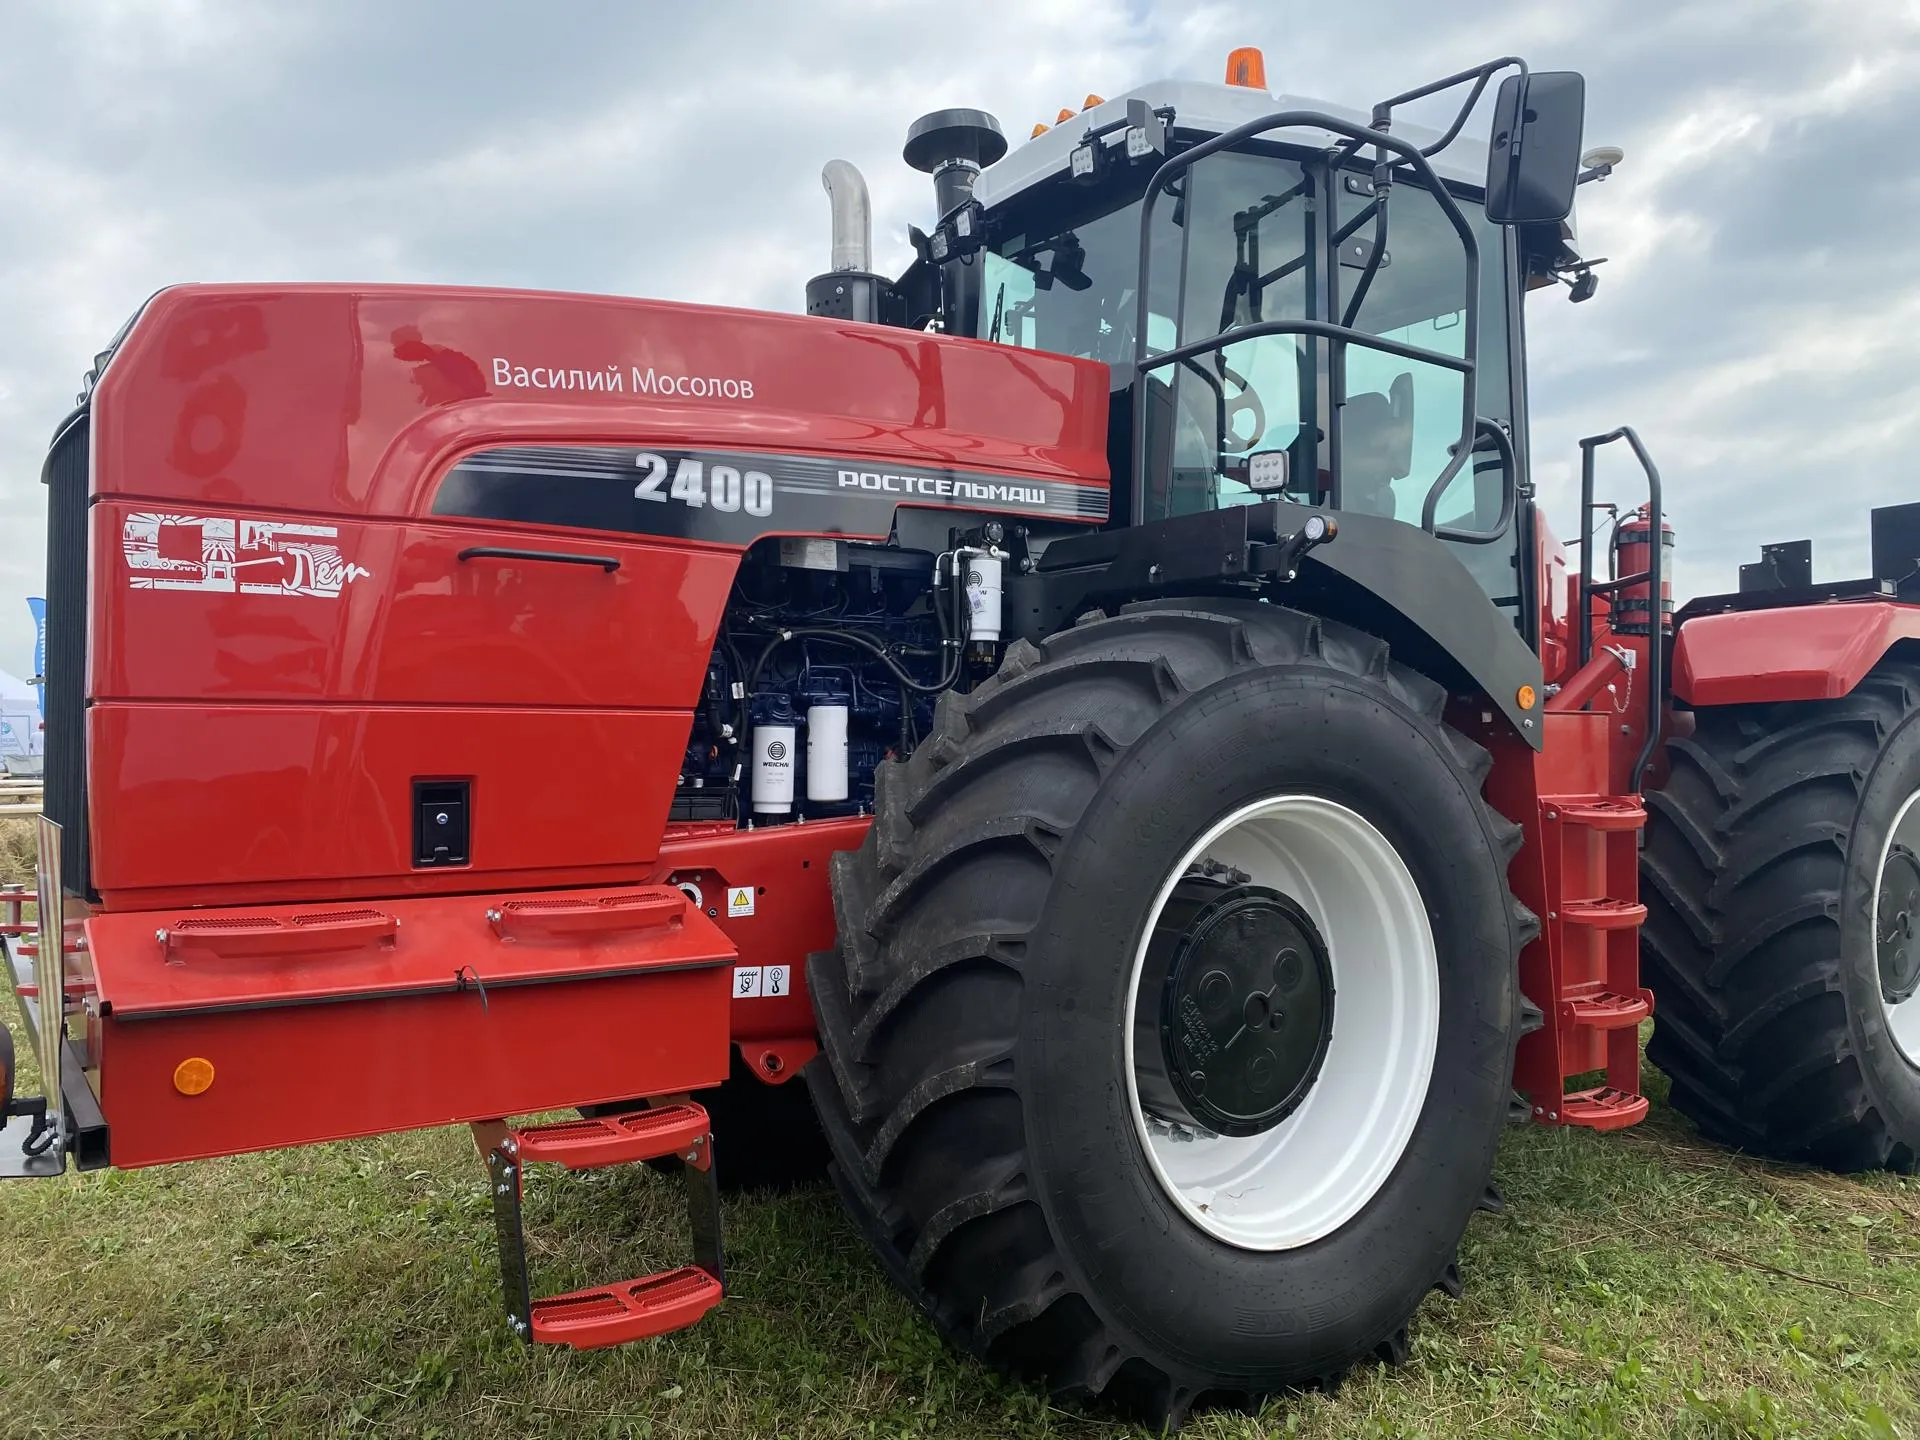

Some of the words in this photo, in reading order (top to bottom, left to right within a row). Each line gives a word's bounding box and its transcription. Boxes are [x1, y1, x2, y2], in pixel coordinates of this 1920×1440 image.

[493, 357, 623, 393] Василий
[632, 366, 755, 399] Мосолов
[634, 452, 774, 517] 2400
[837, 470, 1046, 504] РОСТСЕЛЬМАШ
